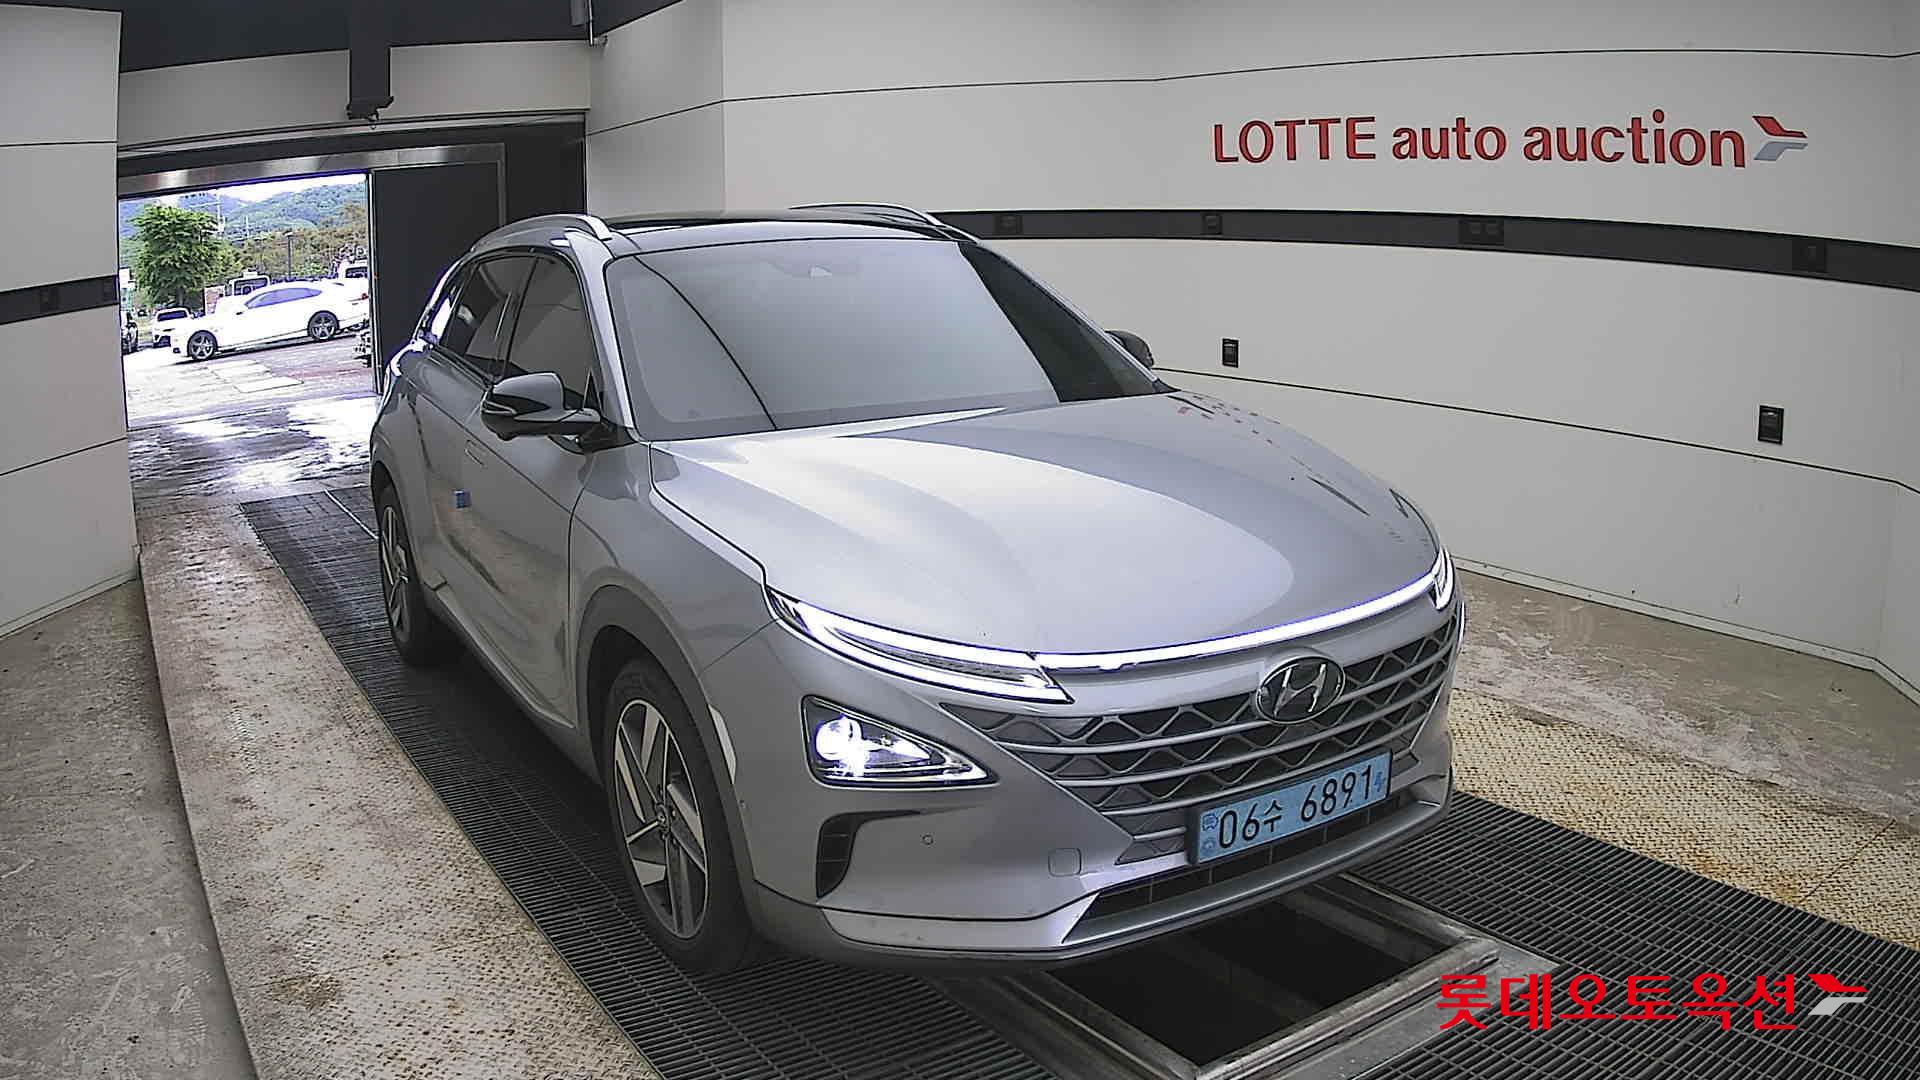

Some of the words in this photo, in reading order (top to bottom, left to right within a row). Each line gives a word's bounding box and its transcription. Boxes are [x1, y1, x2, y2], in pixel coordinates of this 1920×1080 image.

[1213, 116, 1376, 164] LOTTE
[1392, 116, 1507, 162] auto
[1523, 109, 1746, 169] auction
[1219, 800, 1283, 849] 06수
[1300, 764, 1372, 822] 6891
